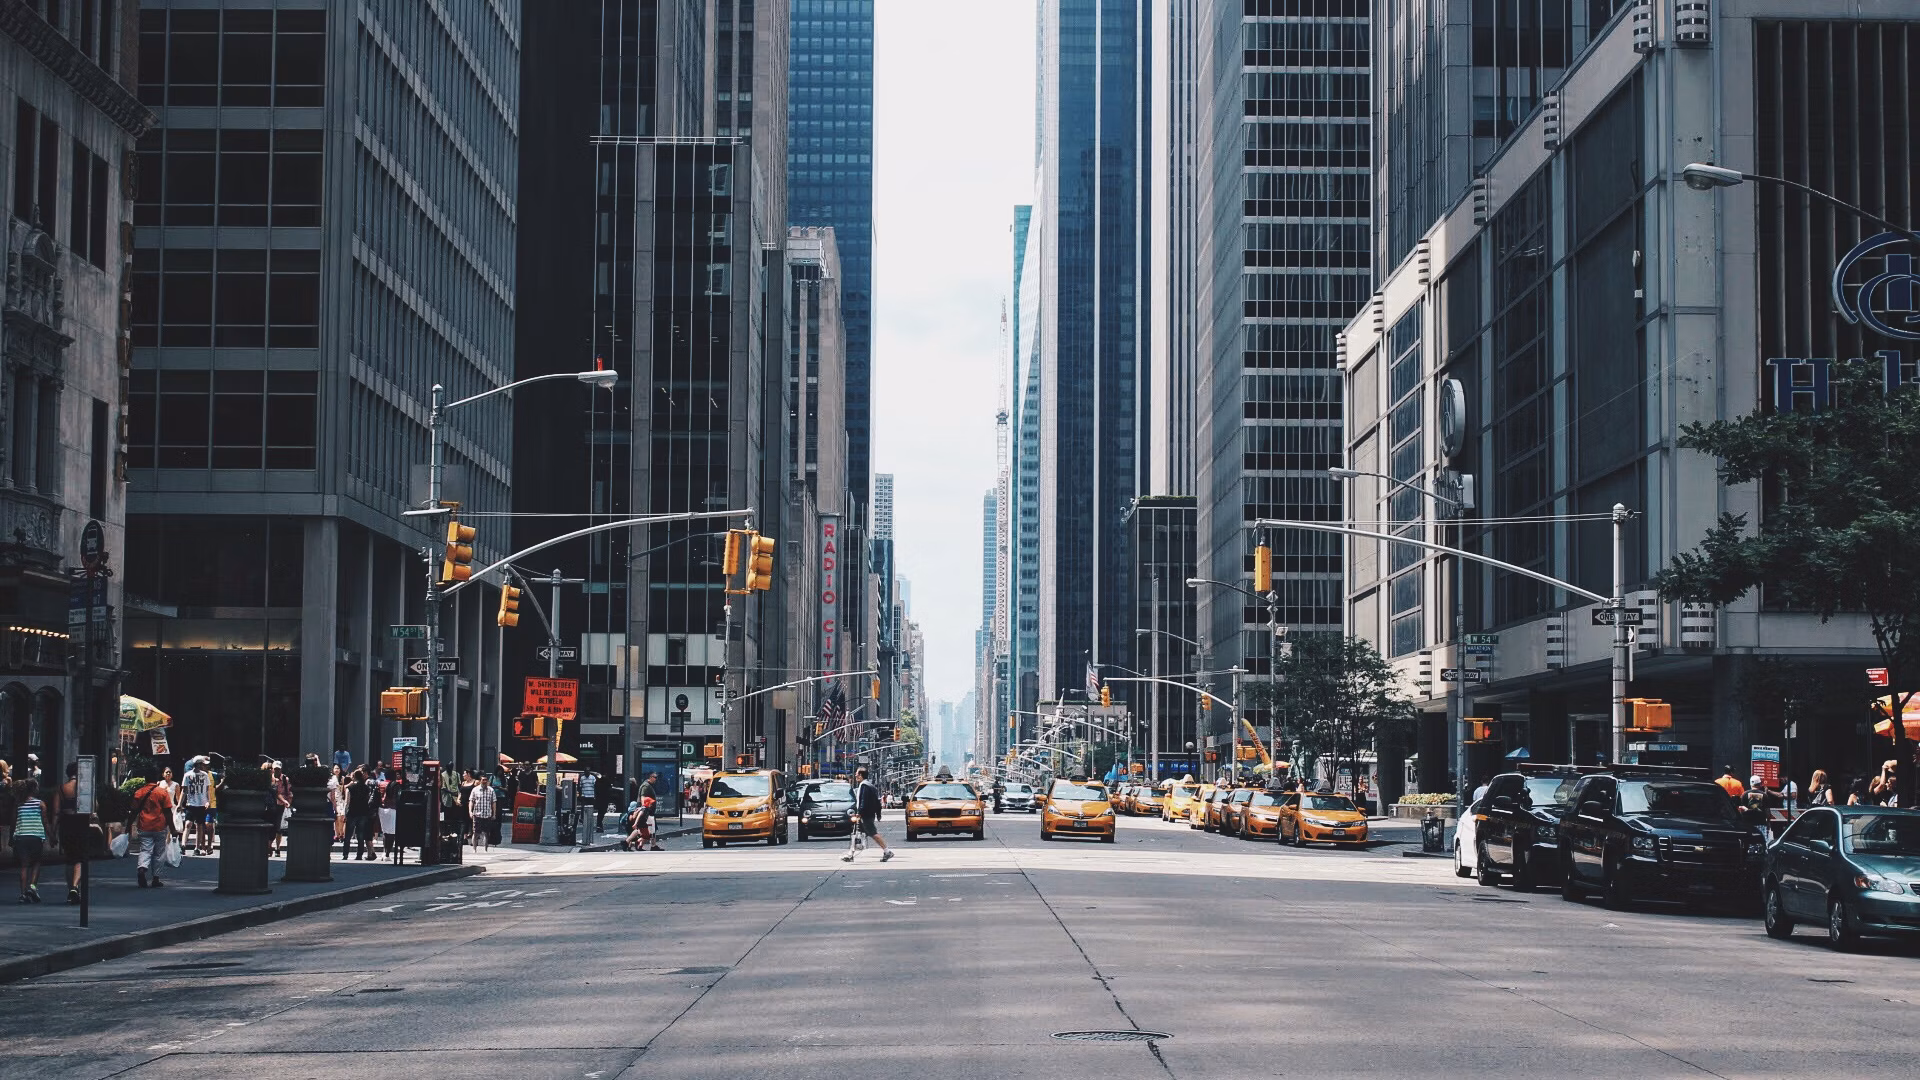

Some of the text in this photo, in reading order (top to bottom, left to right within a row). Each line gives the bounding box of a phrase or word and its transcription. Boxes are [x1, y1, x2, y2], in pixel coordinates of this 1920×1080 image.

[822, 523, 836, 683] RADIO CITY
[392, 627, 399, 637] W
[400, 627, 410, 637] 54
[1481, 635, 1491, 644] 54
